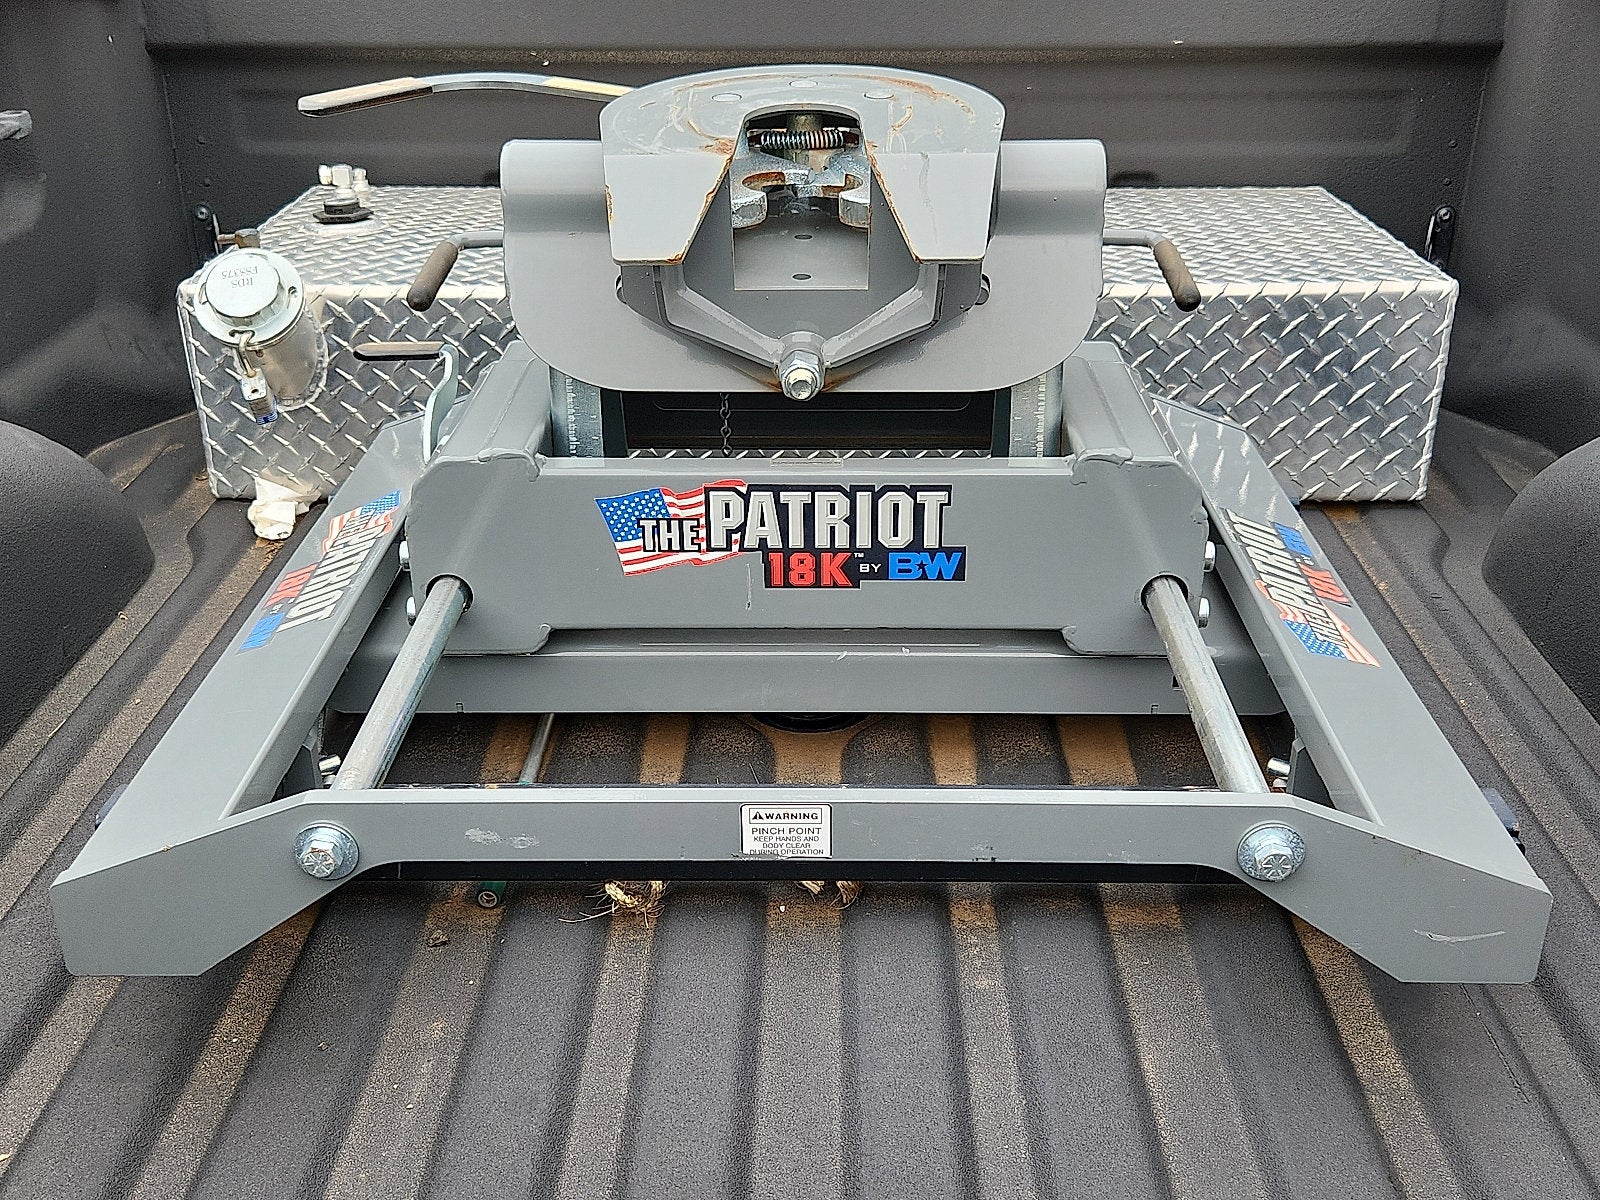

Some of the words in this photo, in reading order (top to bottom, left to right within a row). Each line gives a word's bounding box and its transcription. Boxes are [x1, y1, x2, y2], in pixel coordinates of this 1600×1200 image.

[230, 277, 253, 289] RDS
[340, 509, 376, 538] THE
[640, 519, 701, 551] THE
[708, 491, 949, 549] PATRIOT
[276, 522, 390, 633] PATRIOT
[769, 551, 853, 587] 18K
[859, 563, 881, 573] BY
[1225, 508, 1330, 618] PATRIOT
[263, 563, 319, 609] 18K
[1298, 562, 1350, 603] 18K
[1304, 612, 1349, 649] THE
[765, 812, 818, 820] WARNING
[788, 827, 822, 835] POINT
